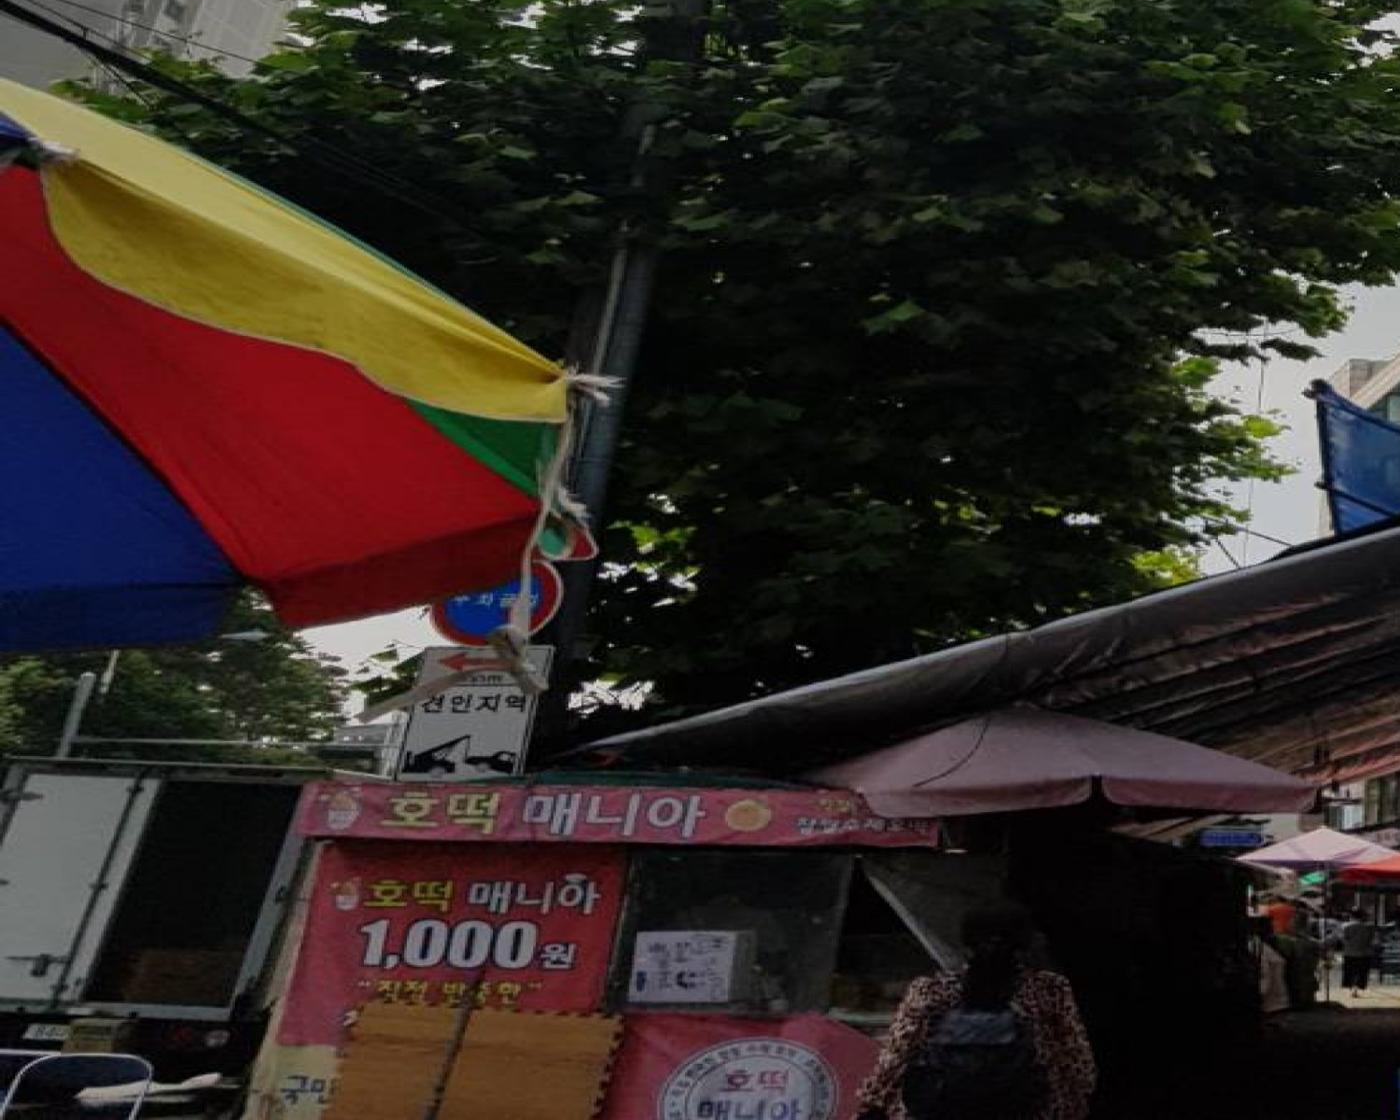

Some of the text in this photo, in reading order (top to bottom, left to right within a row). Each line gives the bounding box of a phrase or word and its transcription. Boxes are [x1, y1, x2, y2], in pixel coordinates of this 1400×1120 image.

[380, 791, 706, 840] 호떡 매니아
[363, 880, 450, 913] 호떡
[719, 1068, 789, 1096] 호떡
